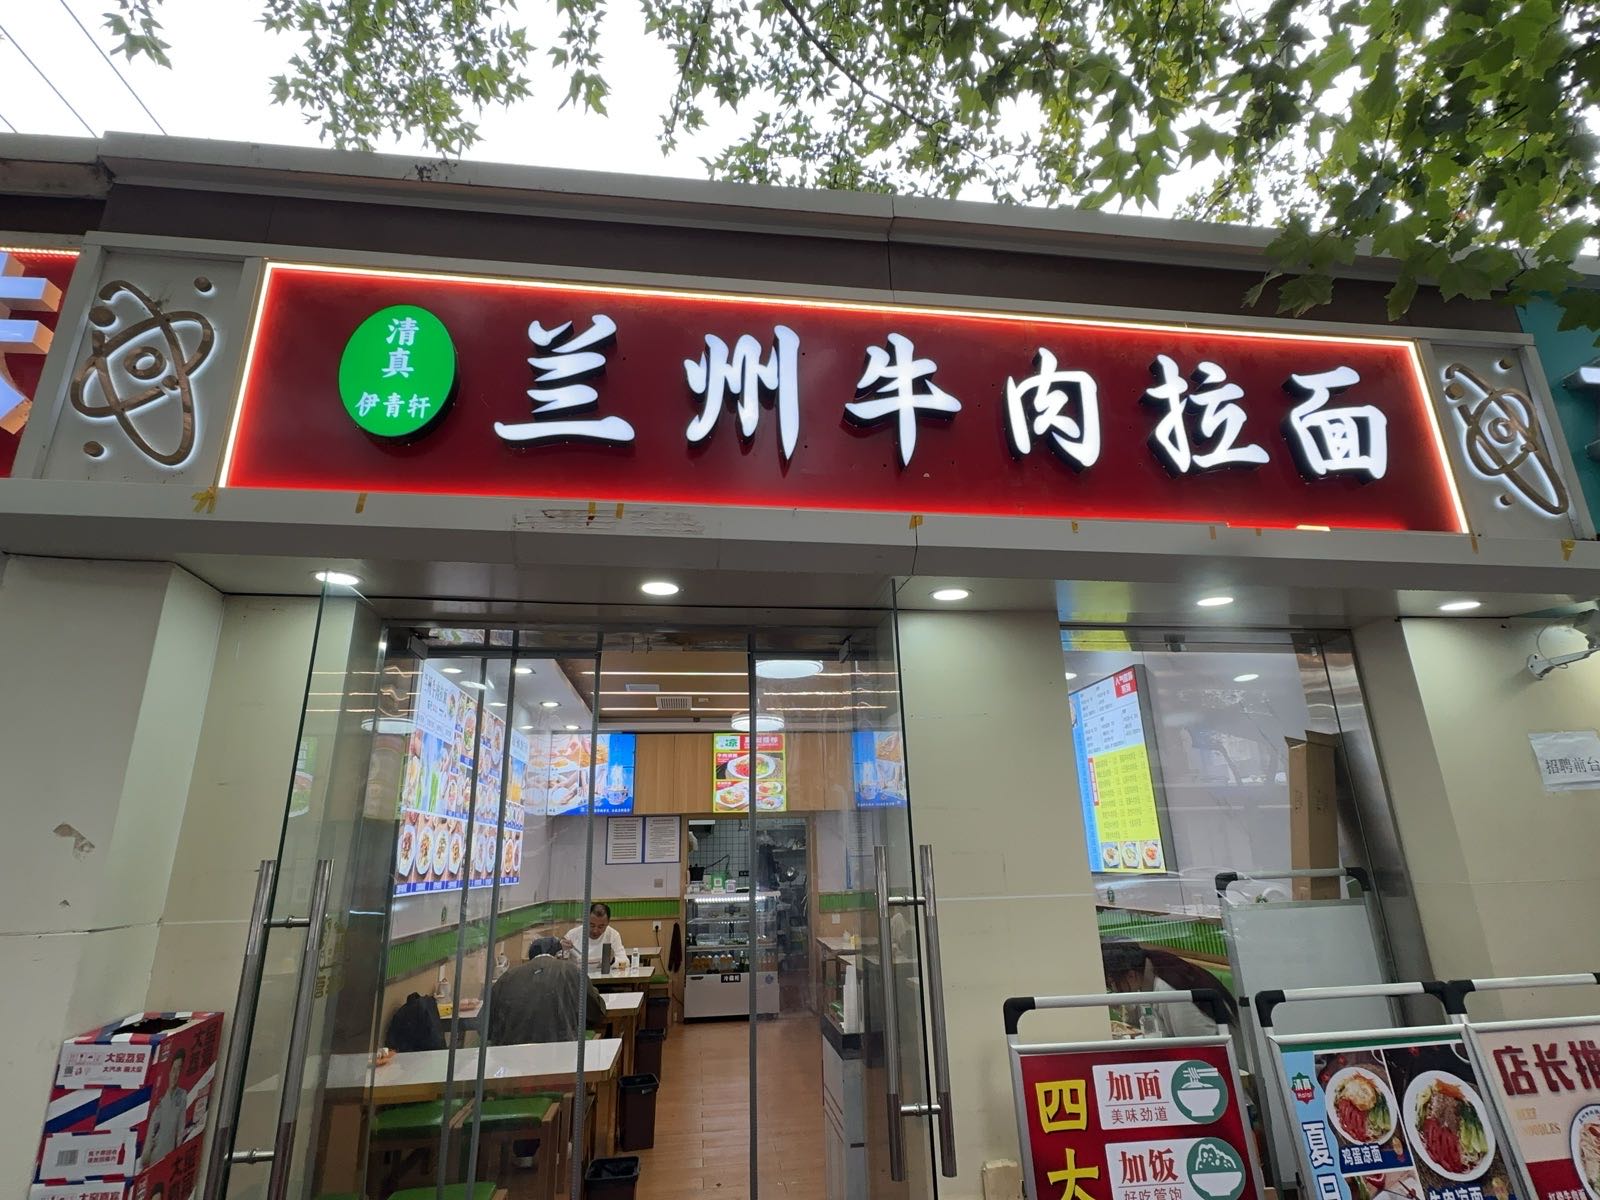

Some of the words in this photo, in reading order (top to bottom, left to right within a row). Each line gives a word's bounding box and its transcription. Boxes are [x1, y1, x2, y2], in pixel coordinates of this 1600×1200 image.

[381, 316, 420, 379] 清真
[355, 391, 432, 419] 伊青轩
[494, 314, 1389, 480] 兰州牛肉拉面
[1545, 756, 1600, 775] 招聘前台
[1106, 1070, 1162, 1102] 加面
[1111, 1106, 1168, 1124] 美味劲道
[1119, 1148, 1179, 1184] 加饭
[1341, 1145, 1384, 1166] 鸡蛋凉面
